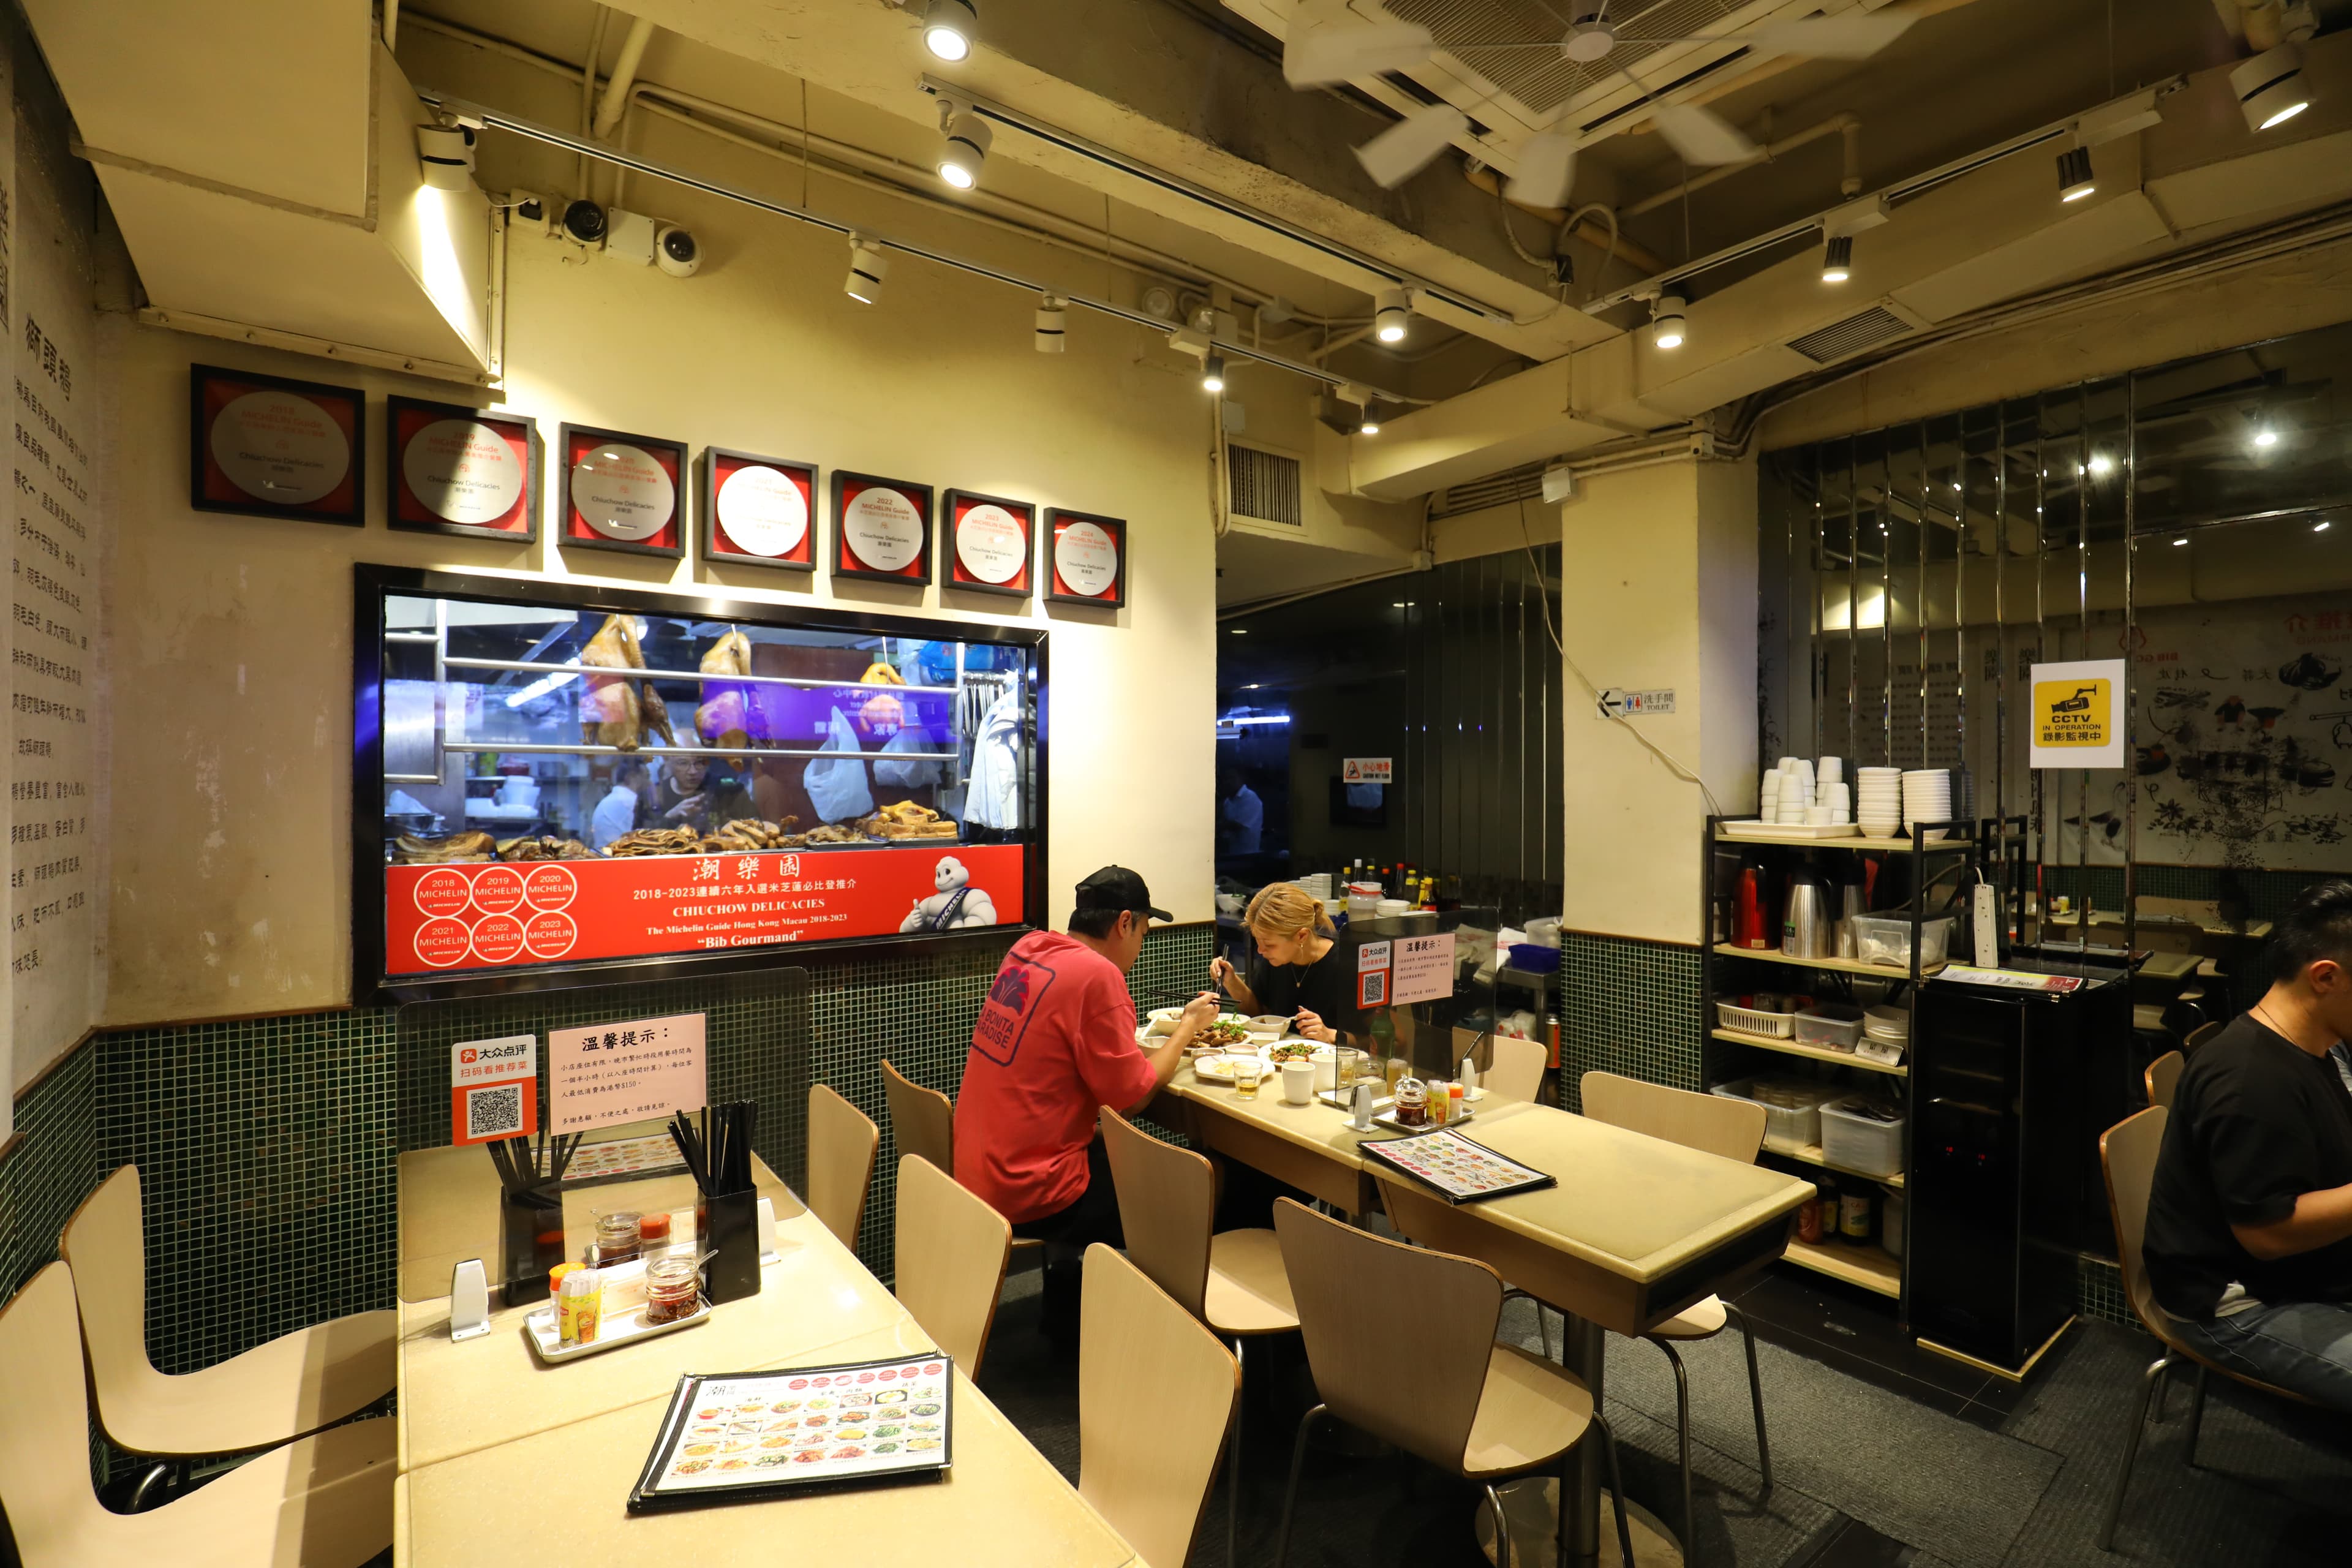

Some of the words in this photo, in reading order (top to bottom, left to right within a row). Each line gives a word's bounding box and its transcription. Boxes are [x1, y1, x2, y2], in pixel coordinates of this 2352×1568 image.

[241, 410, 291, 424] MICHELIN
[429, 435, 472, 450] MICHELIN
[473, 443, 499, 453] Guide
[238, 451, 282, 464] Chiuchow
[283, 457, 325, 469] Delicacies
[427, 475, 464, 486] Chiuchow
[465, 479, 500, 491] Delicacies
[591, 496, 624, 506] Chiuchow
[624, 500, 655, 510] Delicacies
[876, 497, 893, 505] 2022
[861, 503, 892, 513] MICHELIN
[971, 519, 998, 529] MICHELIN
[859, 532, 885, 540] Chiuchow
[1644, 693, 1674, 704] 洗手間
[2051, 714, 2092, 723] CCTV
[2043, 731, 2101, 742] 錄影監視中
[693, 854, 801, 881] 潮樂園
[431, 879, 455, 888] 2018
[487, 877, 510, 886] 2019
[539, 875, 561, 883] 2020
[419, 889, 468, 899] MICHELIN
[475, 886, 521, 896] MICHELIN
[527, 884, 573, 894] MICHELIN
[673, 903, 748, 918] CHIUCHOW
[751, 898, 826, 913] DELICACIES
[935, 888, 967, 931] MICHELIN
[487, 924, 510, 932] 2022
[539, 920, 561, 929] 2023
[646, 926, 663, 935] The
[665, 924, 704, 935] Michelin
[705, 922, 732, 932] Guide
[733, 919, 756, 931] Hong
[758, 918, 780, 929] Kong
[781, 916, 808, 926] Macau
[809, 913, 848, 923] 2018-2023
[431, 927, 454, 936] 2021
[527, 929, 573, 940] MICHELIN
[419, 937, 468, 947] MICHELIN
[475, 933, 521, 943] MICHELIN
[985, 1009, 1015, 1036] BONITA
[581, 1025, 670, 1052] 溫馨提示：
[976, 1018, 1010, 1049] ARADISE
[479, 1043, 527, 1060] 大众点评
[460, 1060, 528, 1078] 扫码看推荐菜
